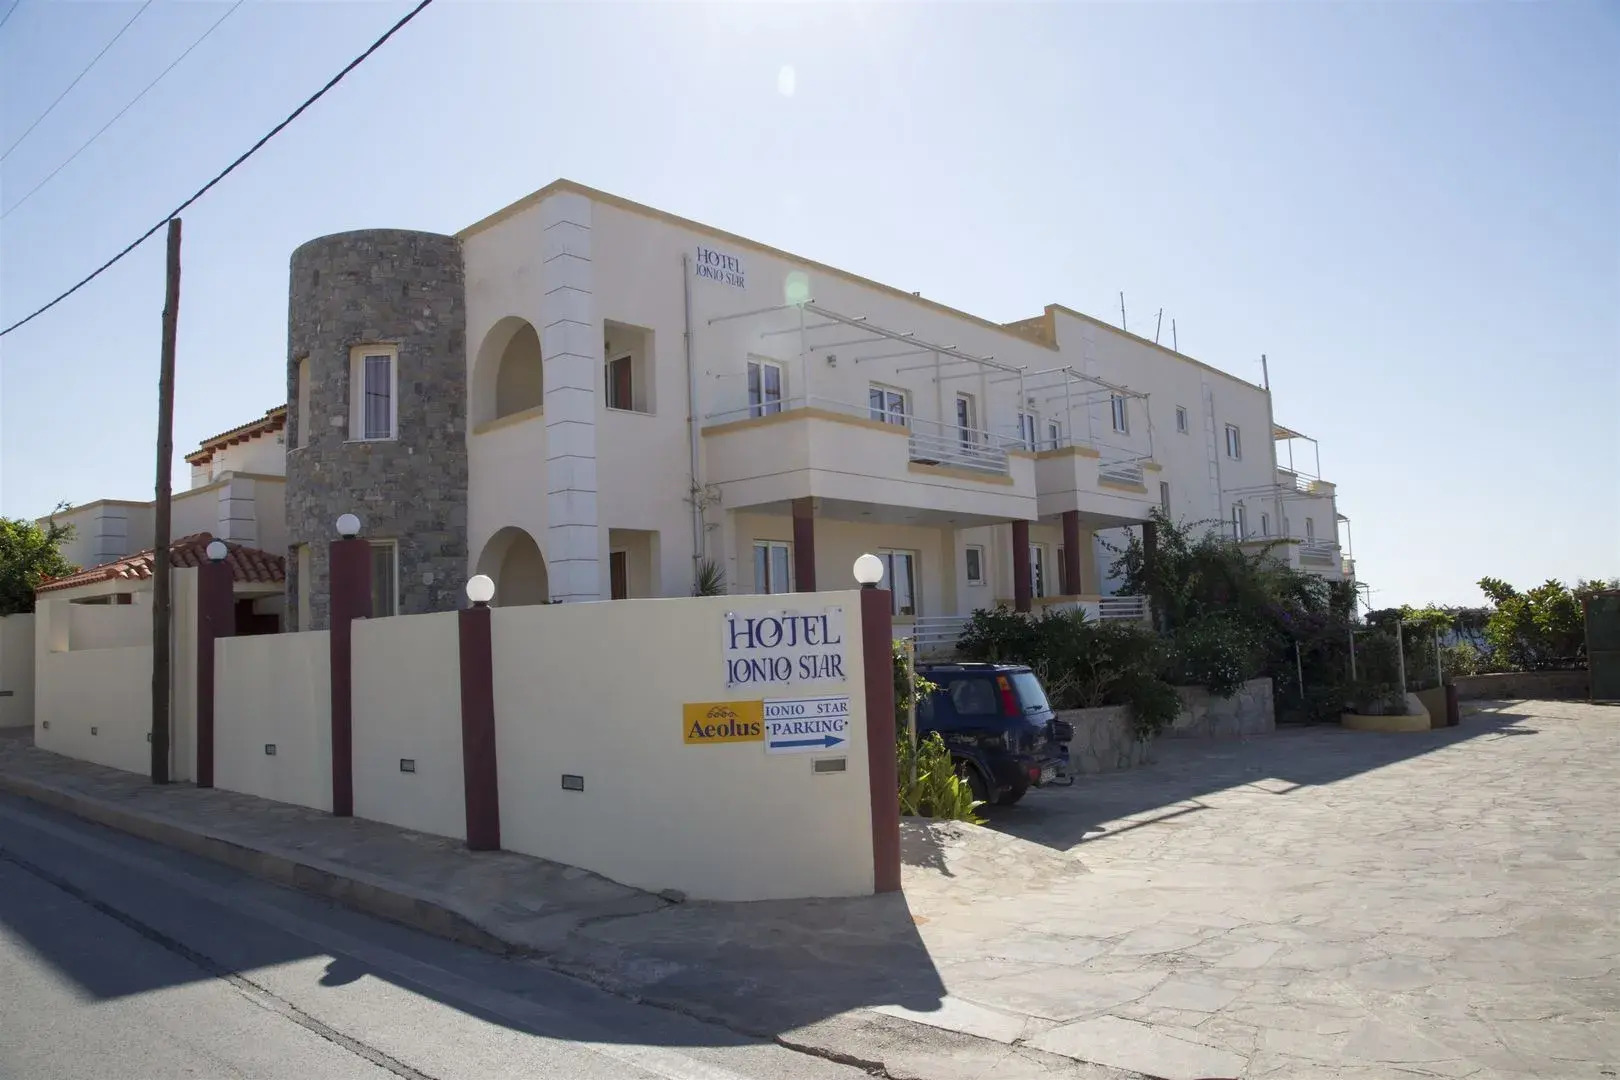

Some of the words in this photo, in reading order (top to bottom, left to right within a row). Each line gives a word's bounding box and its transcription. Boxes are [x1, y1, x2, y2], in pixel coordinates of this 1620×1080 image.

[697, 246, 745, 275] HOTEL
[696, 263, 723, 281] IONIO
[725, 272, 745, 289] STAR
[728, 615, 841, 650] HOTEL
[727, 656, 792, 684] IONIO
[799, 654, 845, 680] STAR
[766, 704, 805, 716] IONIO
[816, 702, 848, 714] STAR
[688, 718, 761, 739] Aeolus
[772, 719, 844, 736] PARKING
